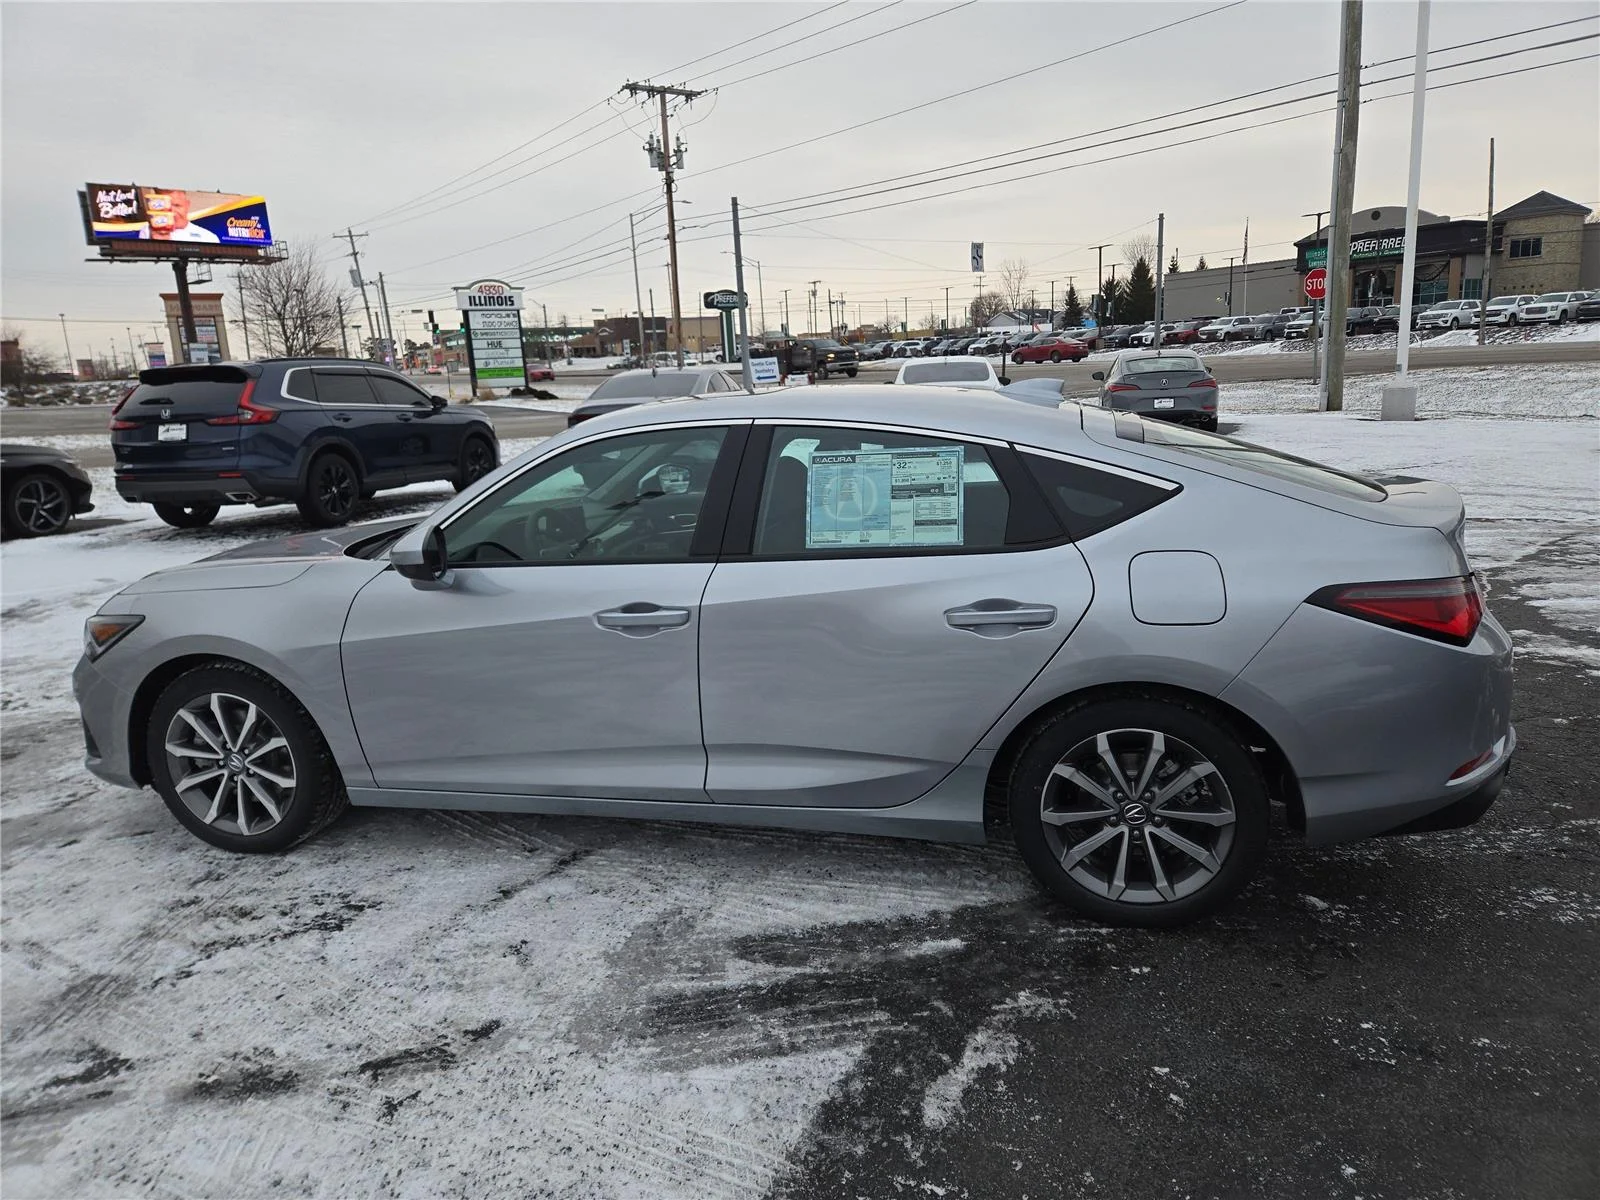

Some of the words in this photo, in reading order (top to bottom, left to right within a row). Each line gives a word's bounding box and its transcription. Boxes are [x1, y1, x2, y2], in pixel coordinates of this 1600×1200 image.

[477, 284, 504, 295] 4930
[468, 295, 515, 307] ILLINOIS
[486, 340, 503, 348] HUE
[896, 461, 907, 469] 32
